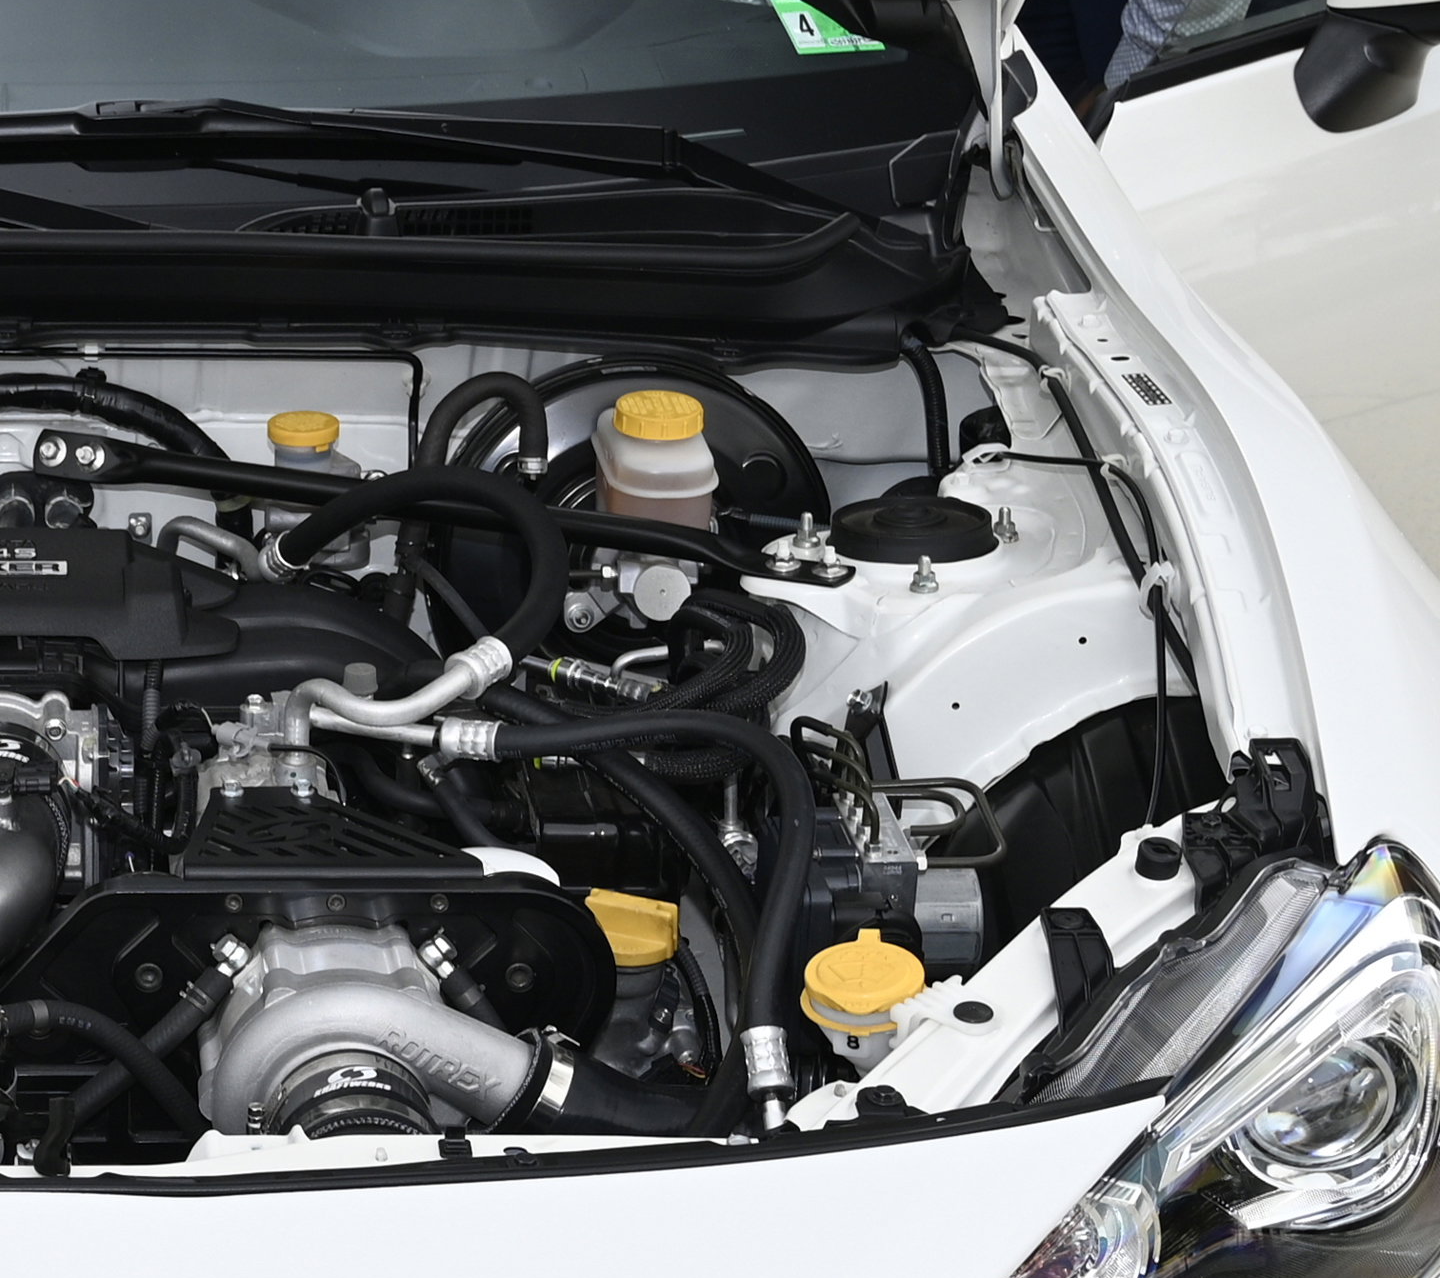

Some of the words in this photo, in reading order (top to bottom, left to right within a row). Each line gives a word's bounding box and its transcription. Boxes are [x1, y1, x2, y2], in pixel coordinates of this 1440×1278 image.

[799, 13, 815, 37] 4
[846, 1034, 860, 1050] 8
[313, 1079, 392, 1098] KRAFTWERKS
